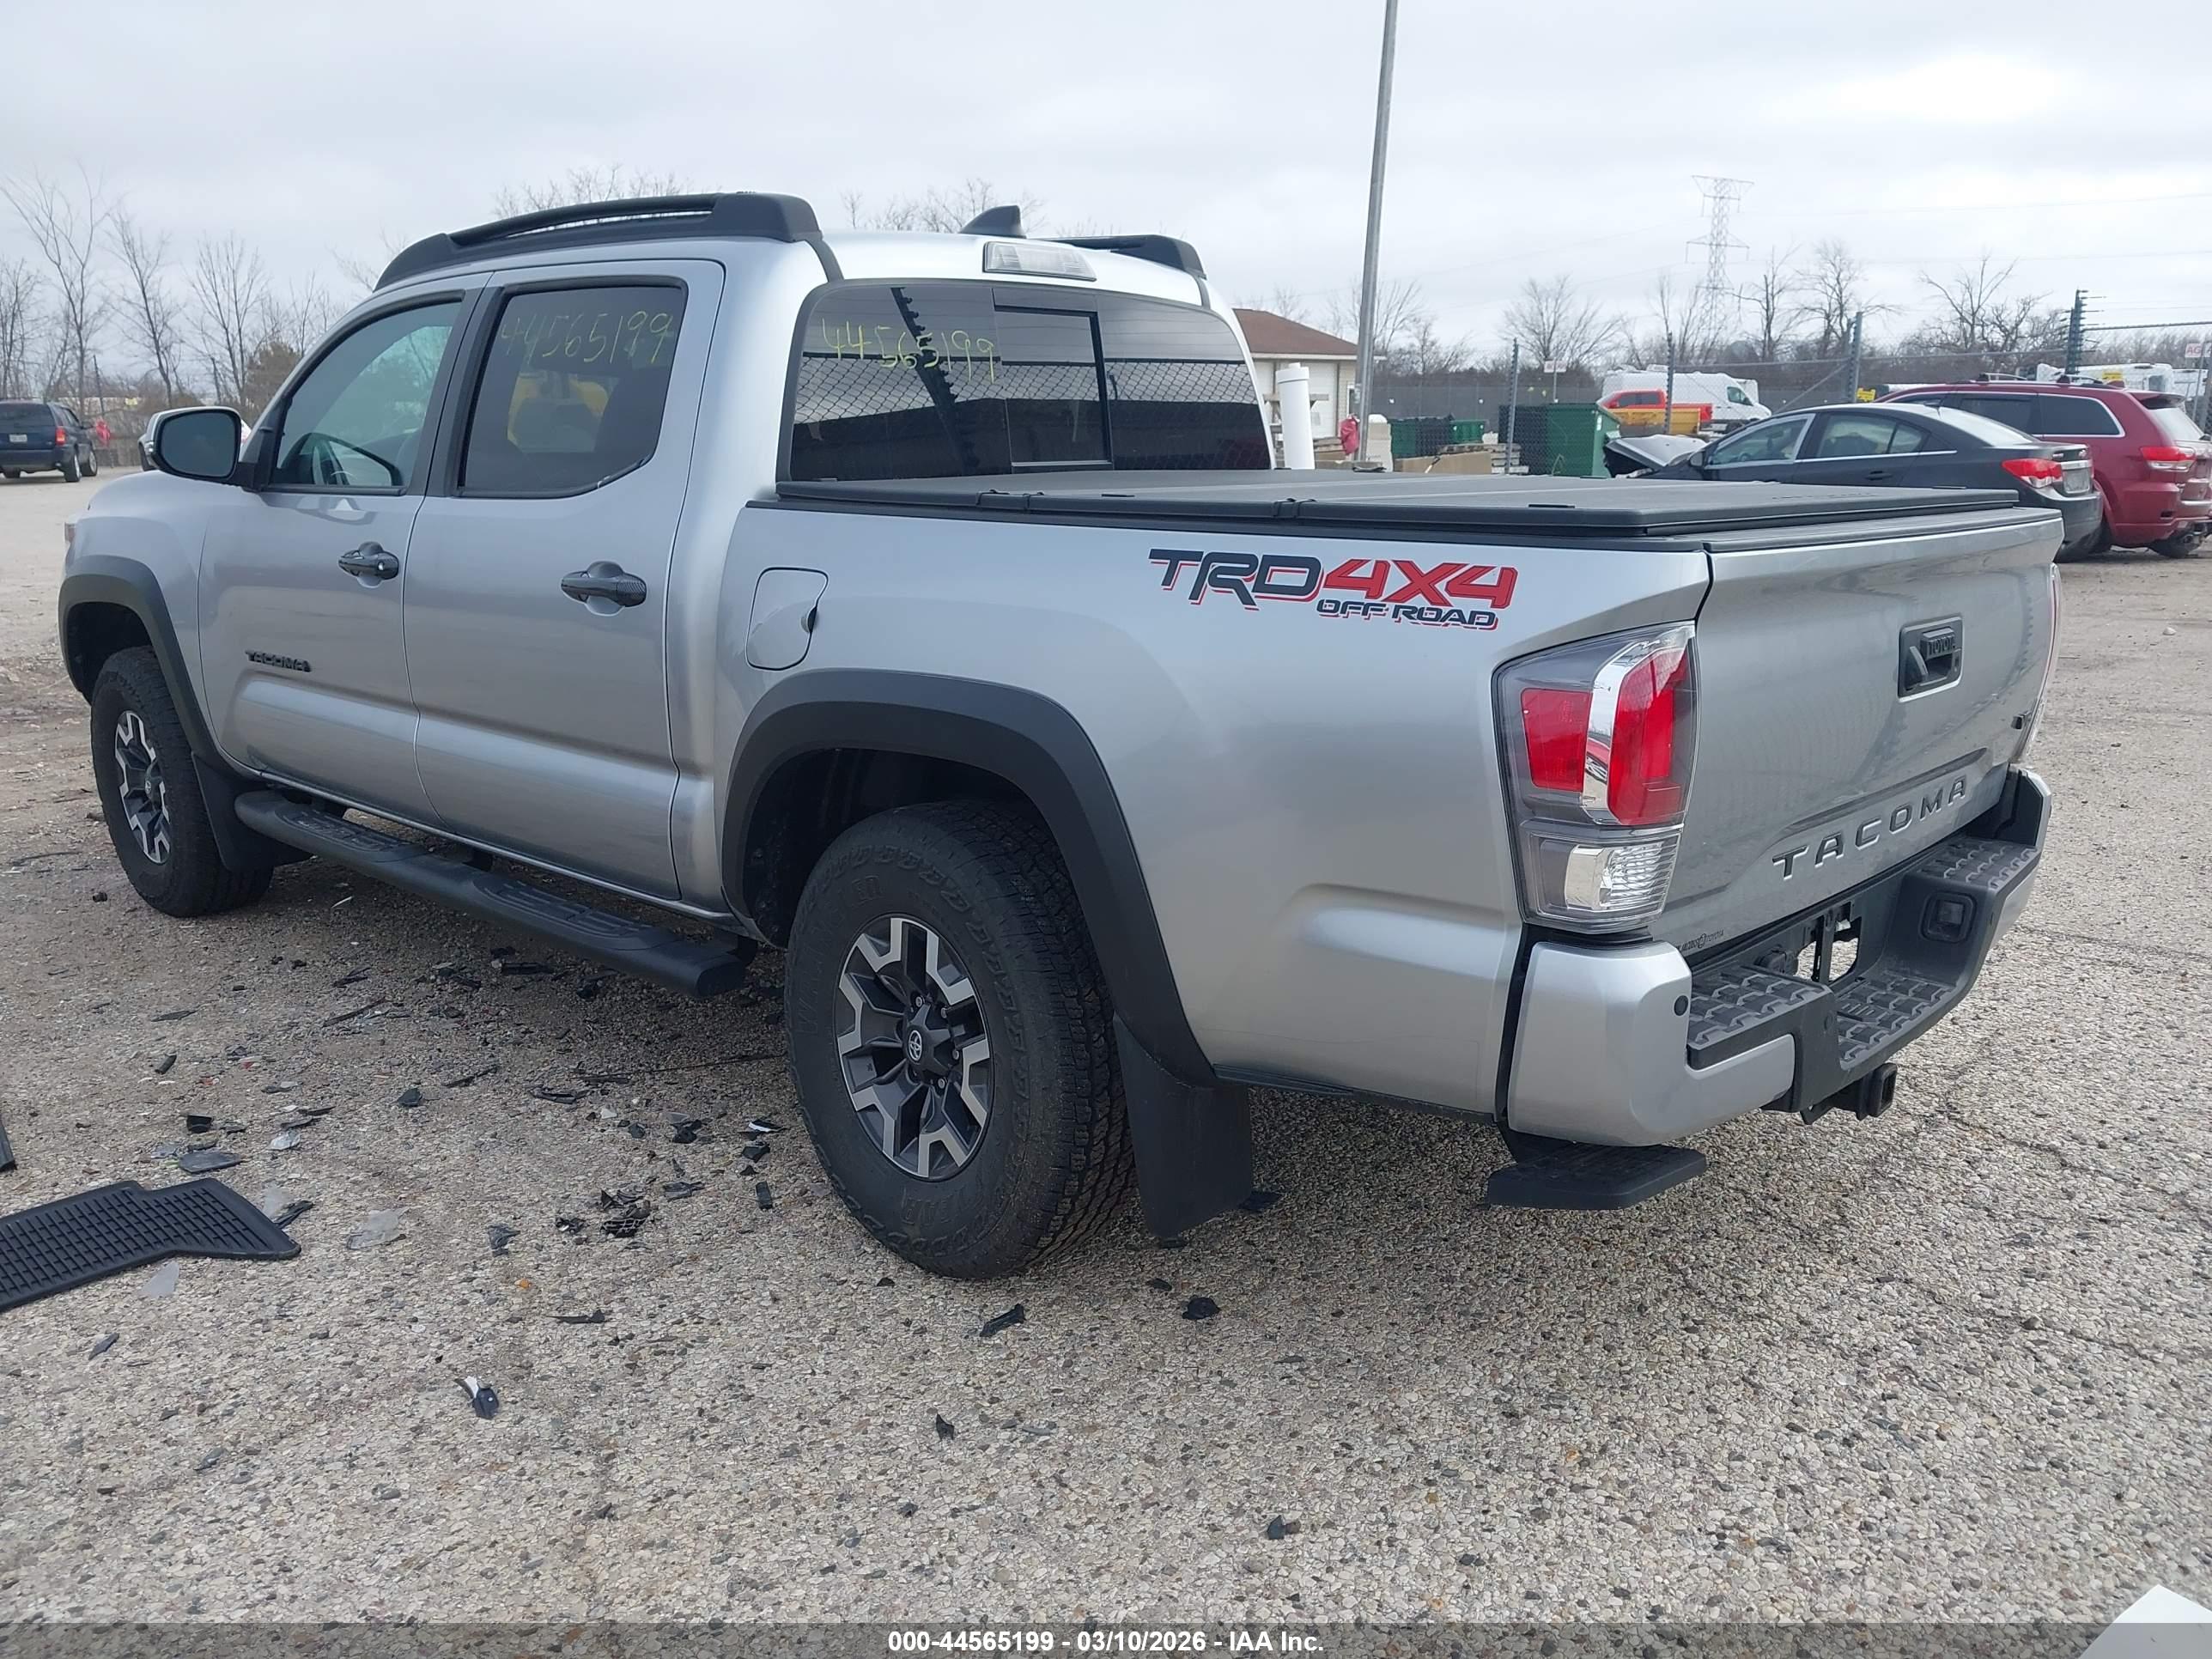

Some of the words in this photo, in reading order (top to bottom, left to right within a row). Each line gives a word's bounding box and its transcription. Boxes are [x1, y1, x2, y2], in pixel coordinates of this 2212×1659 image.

[501, 310, 676, 364] 44565199
[821, 317, 996, 384] 44565199
[1147, 548, 1324, 611] TRD
[1324, 557, 1518, 610] 4X4
[1316, 599, 1390, 618] OFF
[1390, 605, 1499, 631] ROAD
[1772, 774, 1968, 880] TACOMA
